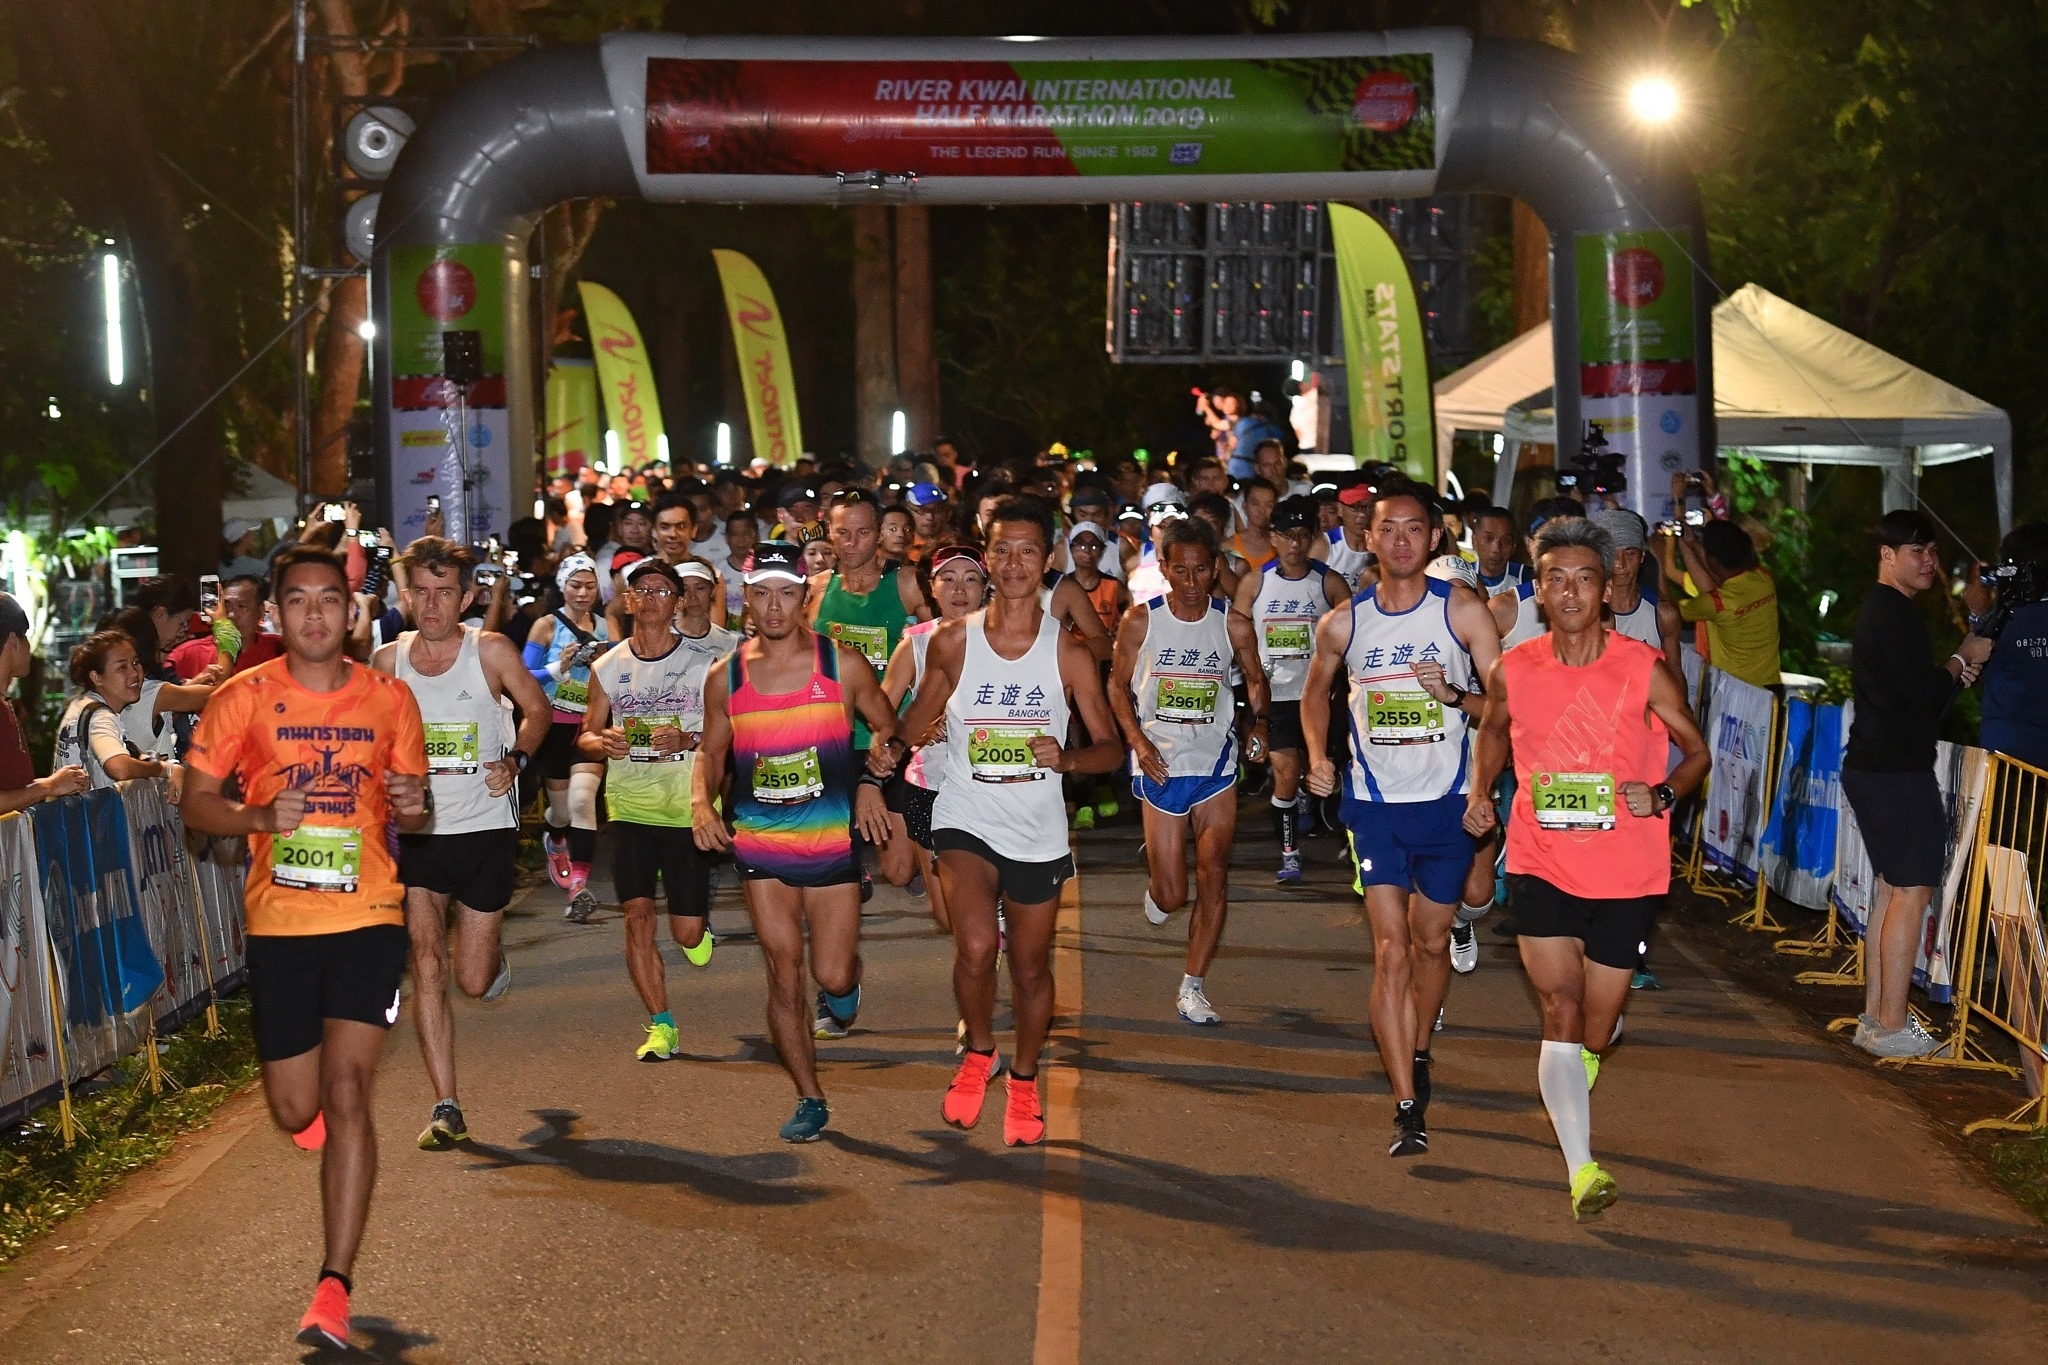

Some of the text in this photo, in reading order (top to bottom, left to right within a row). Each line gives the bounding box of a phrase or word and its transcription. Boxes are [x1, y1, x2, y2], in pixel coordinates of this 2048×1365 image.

[875, 78, 1235, 100] RIVER KWAI INTERNATIONAL
[915, 104, 1204, 129] HALF MARATHON 2019
[929, 146, 959, 158] THE
[966, 146, 1027, 158] LEGEND
[1033, 146, 1066, 158] RUN
[1073, 146, 1118, 158] SINCE
[1125, 146, 1158, 158] 1982
[1265, 600, 1316, 614] 走遊会
[1268, 638, 1297, 647] 2684
[1156, 648, 1221, 668] 走遊会
[1363, 642, 1440, 671] 走遊会
[973, 683, 1045, 706] 走遊会
[1165, 695, 1201, 708] 2961
[1008, 709, 1051, 718] BANGKOK
[1376, 711, 1422, 725] 2559
[631, 733, 653, 746] 296
[425, 742, 458, 756] 882
[977, 748, 1026, 763] 2005
[760, 773, 800, 787] 2519
[1545, 793, 1587, 809] 2121
[282, 847, 334, 868] 2001
